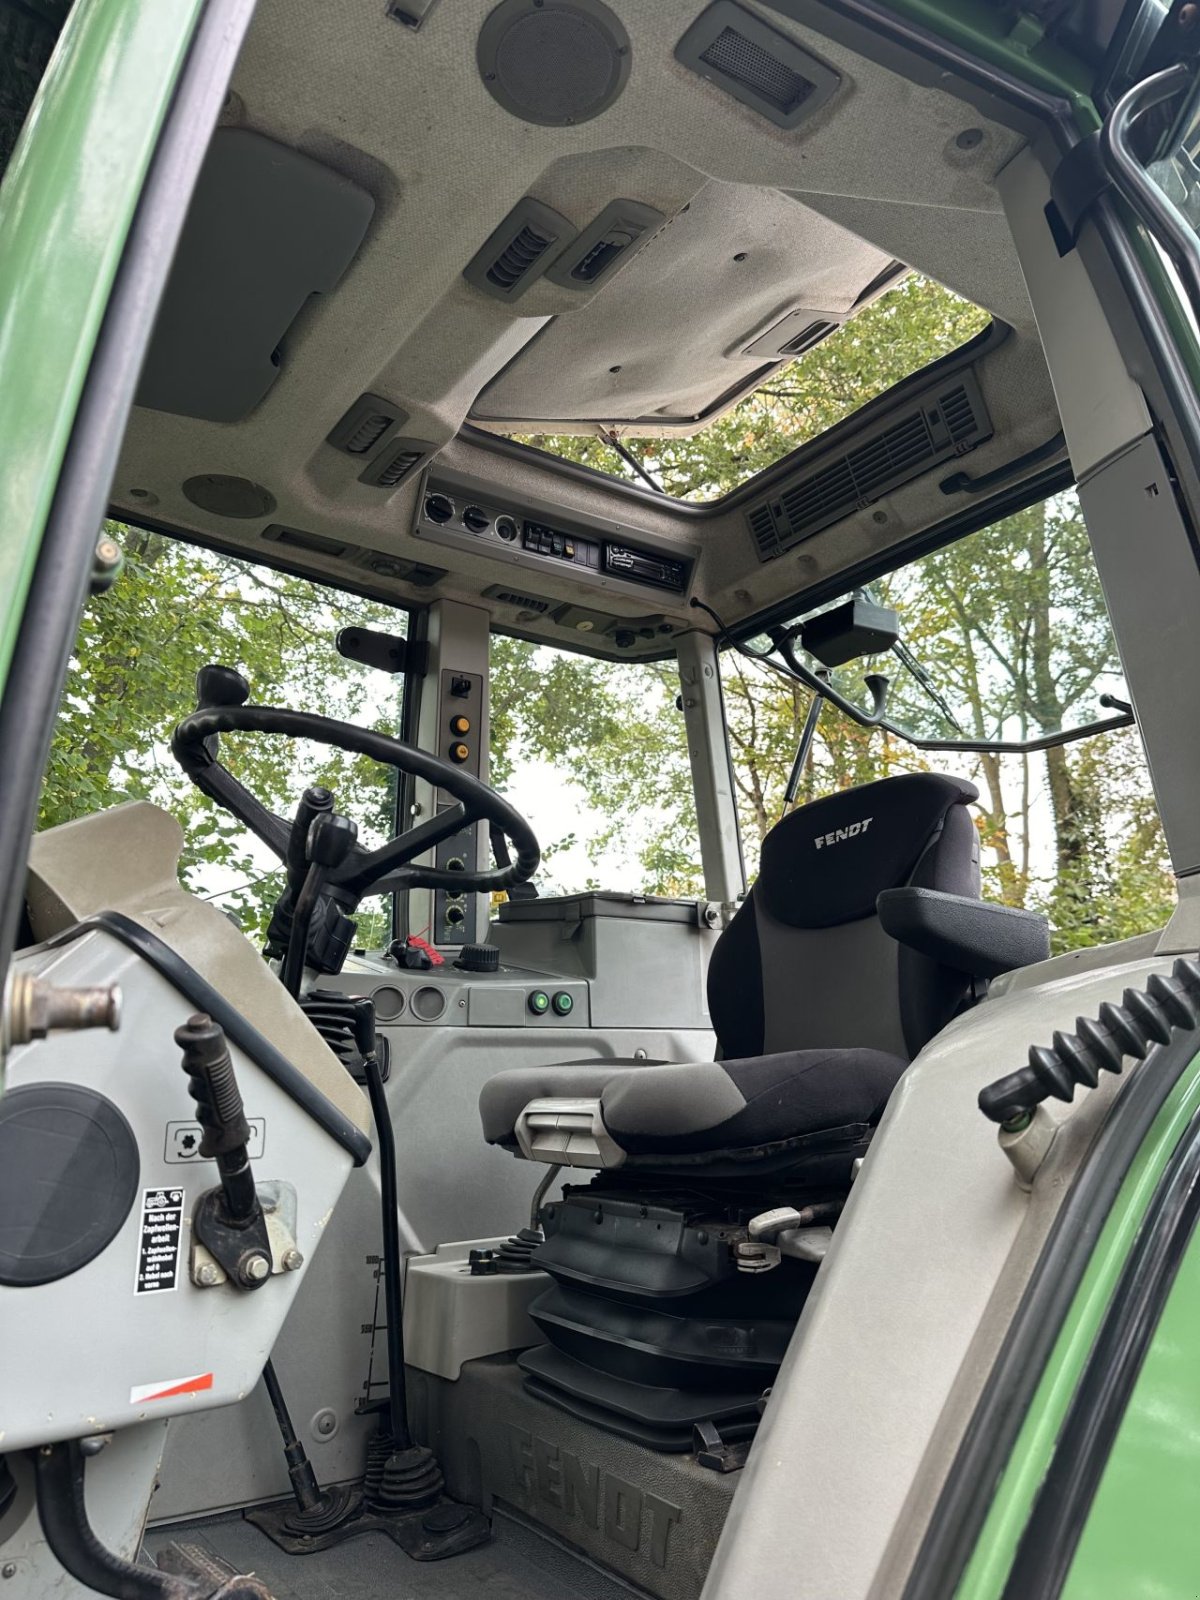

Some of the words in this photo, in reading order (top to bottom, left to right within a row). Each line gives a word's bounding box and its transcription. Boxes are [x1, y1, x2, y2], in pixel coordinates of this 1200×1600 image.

[814, 817, 873, 849] FENDT
[148, 1213, 164, 1222] Nach
[165, 1213, 177, 1221] der
[151, 1235, 170, 1243] arbeit
[503, 1420, 682, 1568] FENDT
